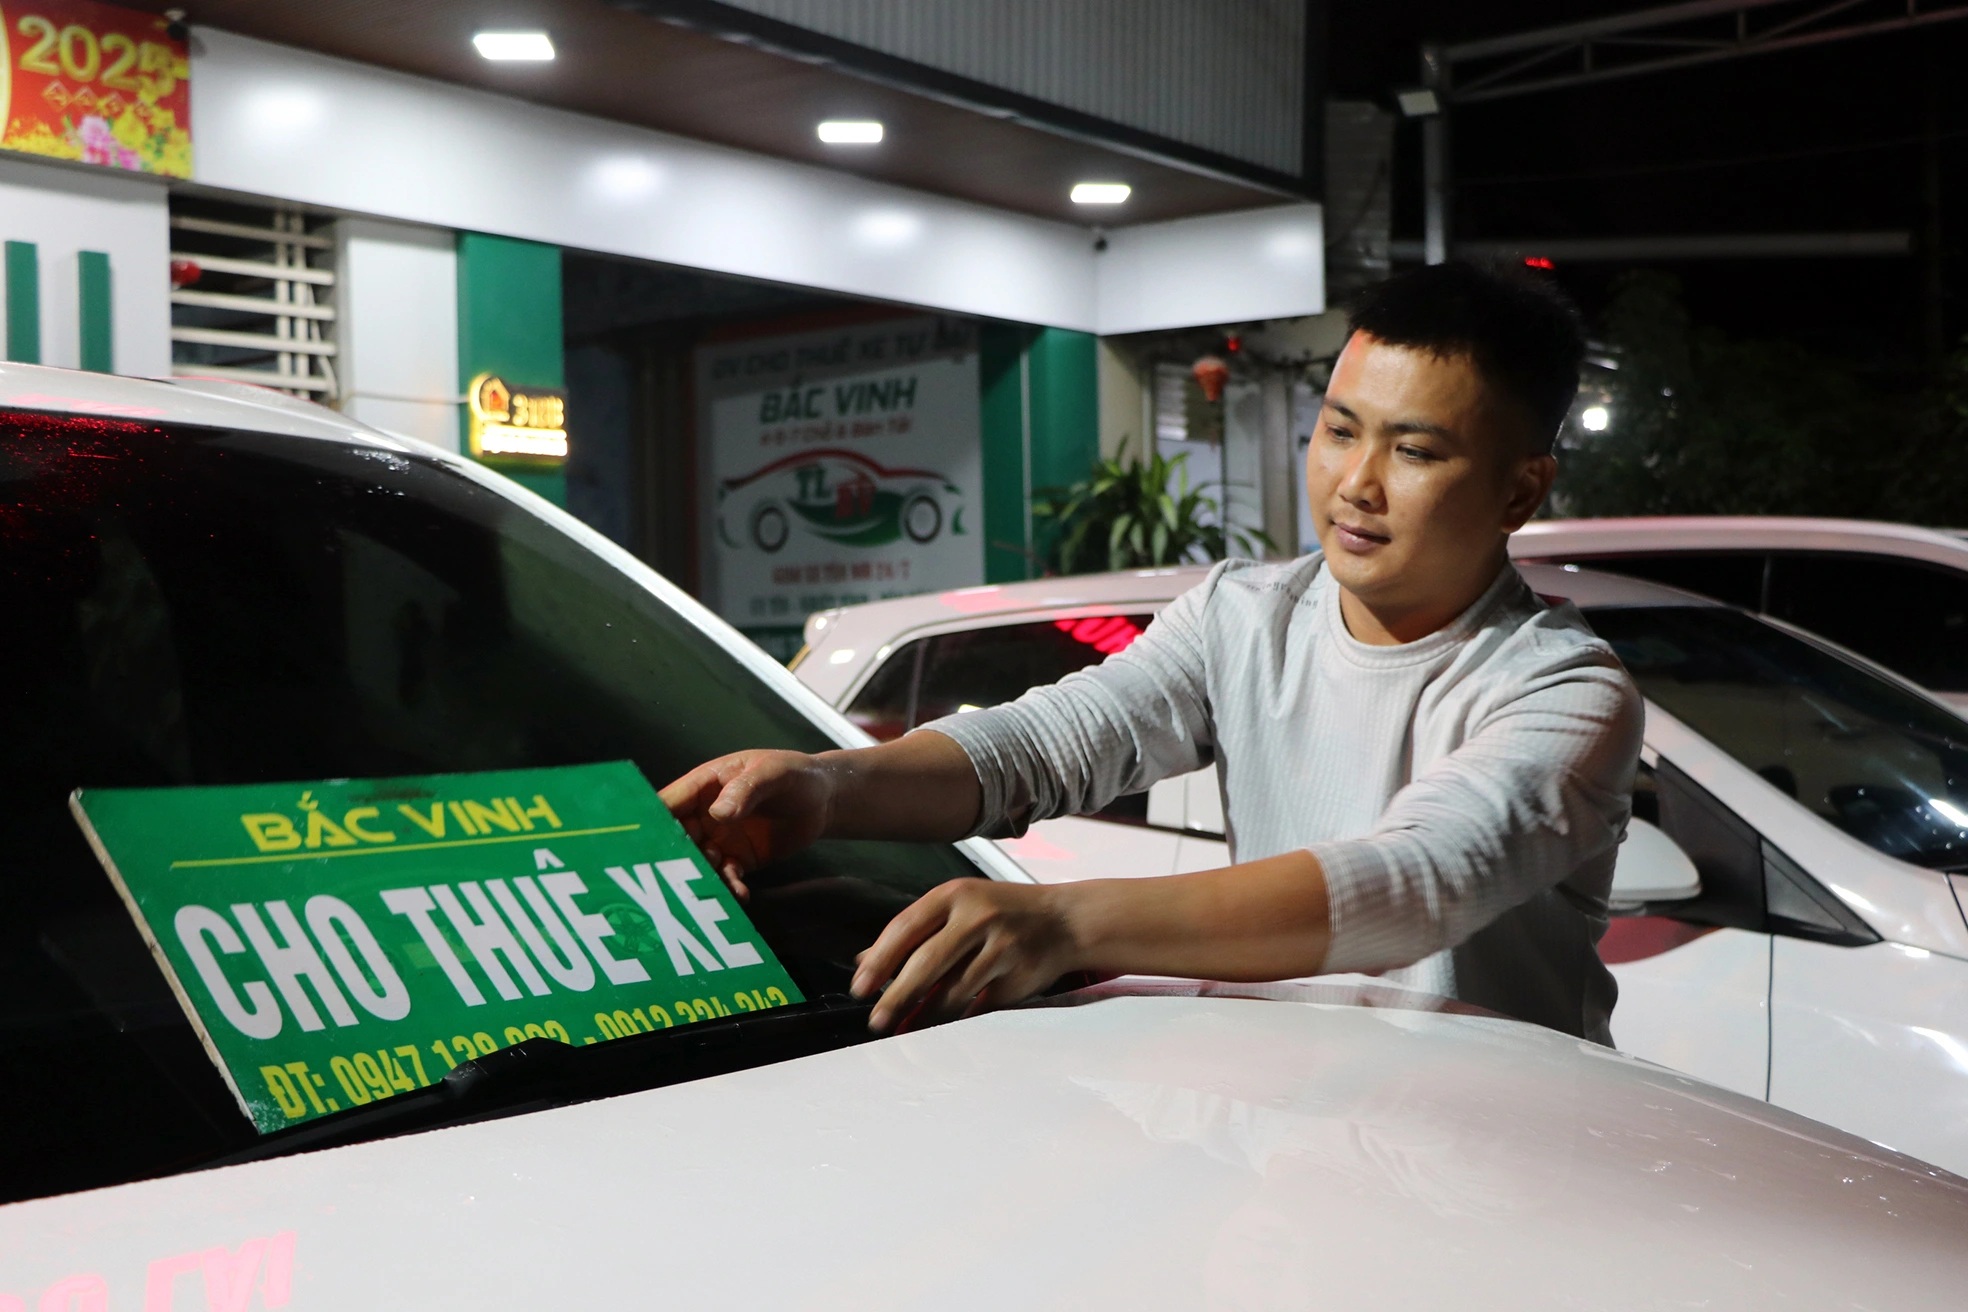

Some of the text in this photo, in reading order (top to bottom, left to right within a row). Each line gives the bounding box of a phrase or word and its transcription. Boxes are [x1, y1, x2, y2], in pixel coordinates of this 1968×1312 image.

[18, 15, 177, 98] 2025
[834, 377, 919, 415] VINH
[240, 791, 563, 851] BẮC VINH
[174, 848, 765, 1040] CHO THUÊ XE
[259, 1061, 341, 1119] ĐT:
[329, 1044, 431, 1106] 0947
